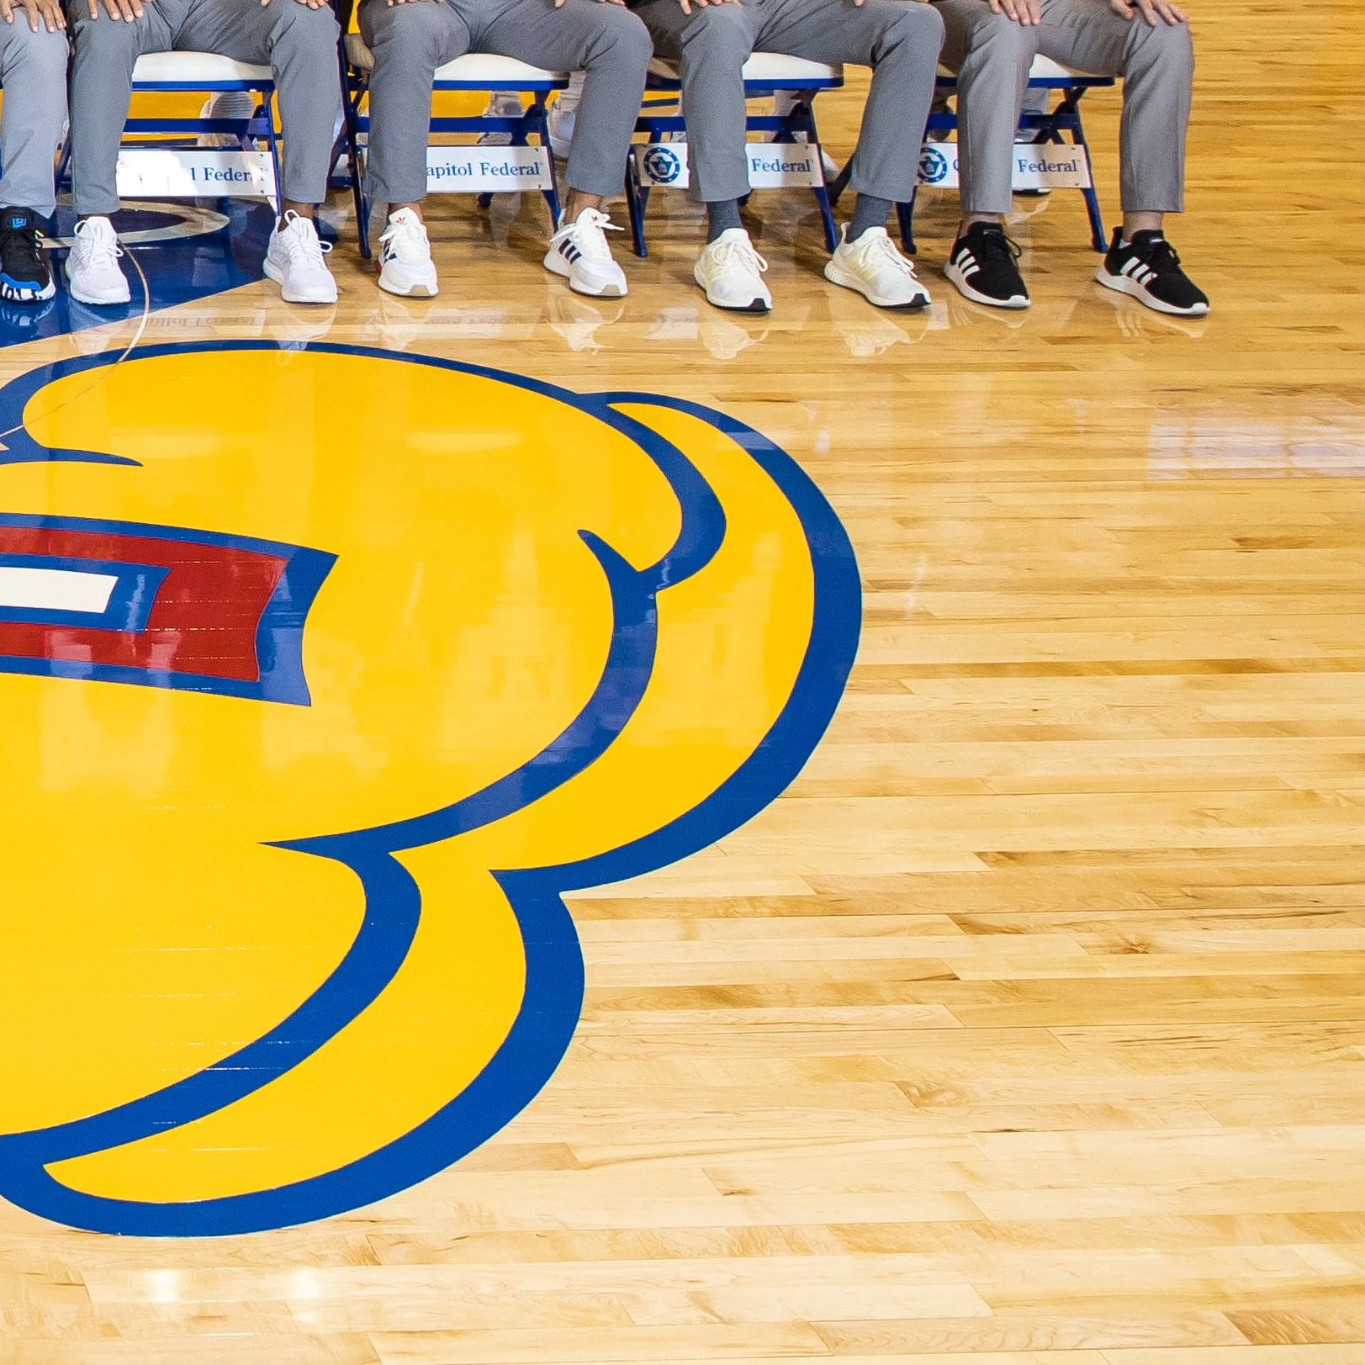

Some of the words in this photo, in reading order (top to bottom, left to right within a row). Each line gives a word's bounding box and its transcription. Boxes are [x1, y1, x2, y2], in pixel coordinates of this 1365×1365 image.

[426, 163, 471, 179] apitol
[480, 162, 540, 176] Federal
[751, 158, 811, 172] Federal
[1018, 158, 1077, 172] Federal
[204, 167, 250, 181] Feder
